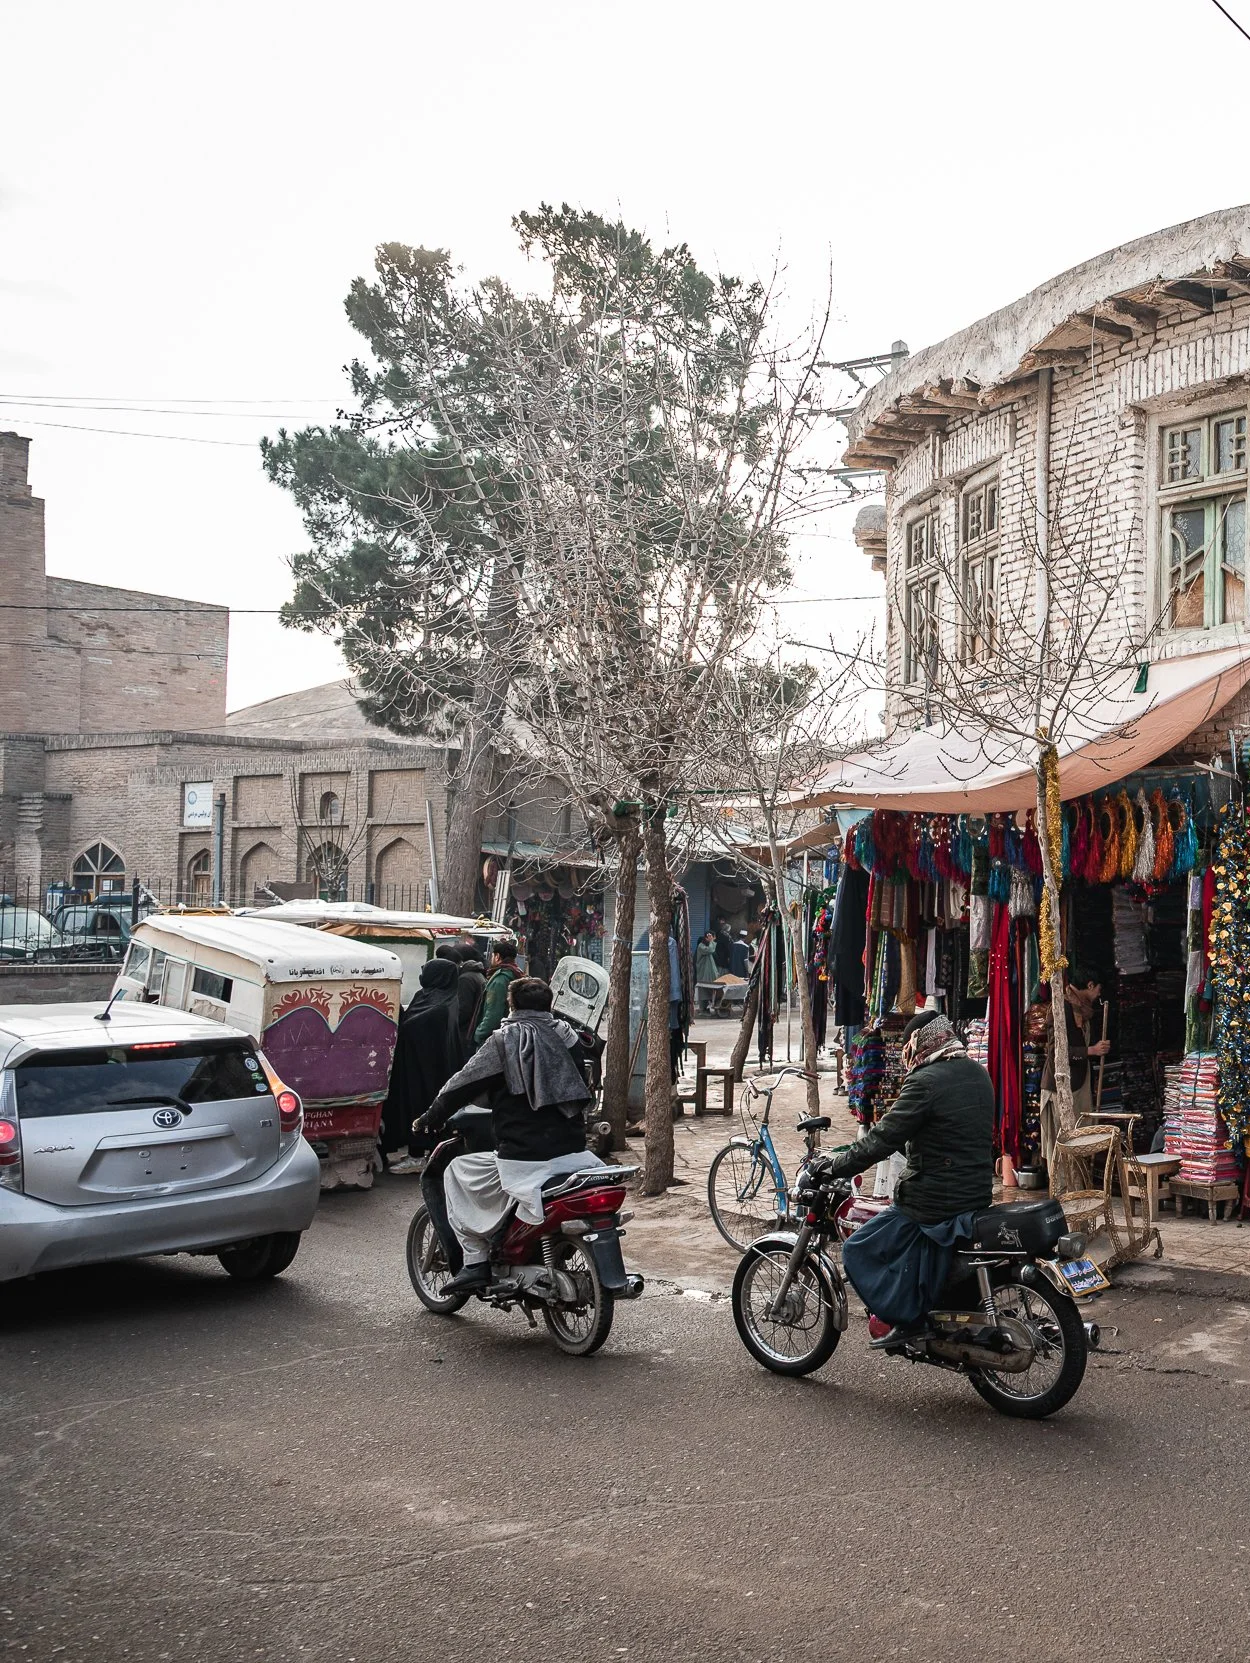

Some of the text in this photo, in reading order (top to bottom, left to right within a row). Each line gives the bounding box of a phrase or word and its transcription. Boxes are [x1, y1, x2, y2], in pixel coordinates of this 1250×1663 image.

[304, 1110, 334, 1120] FGHAN
[302, 1119, 334, 1129] RIANA
[33, 1144, 76, 1154] AQUA
